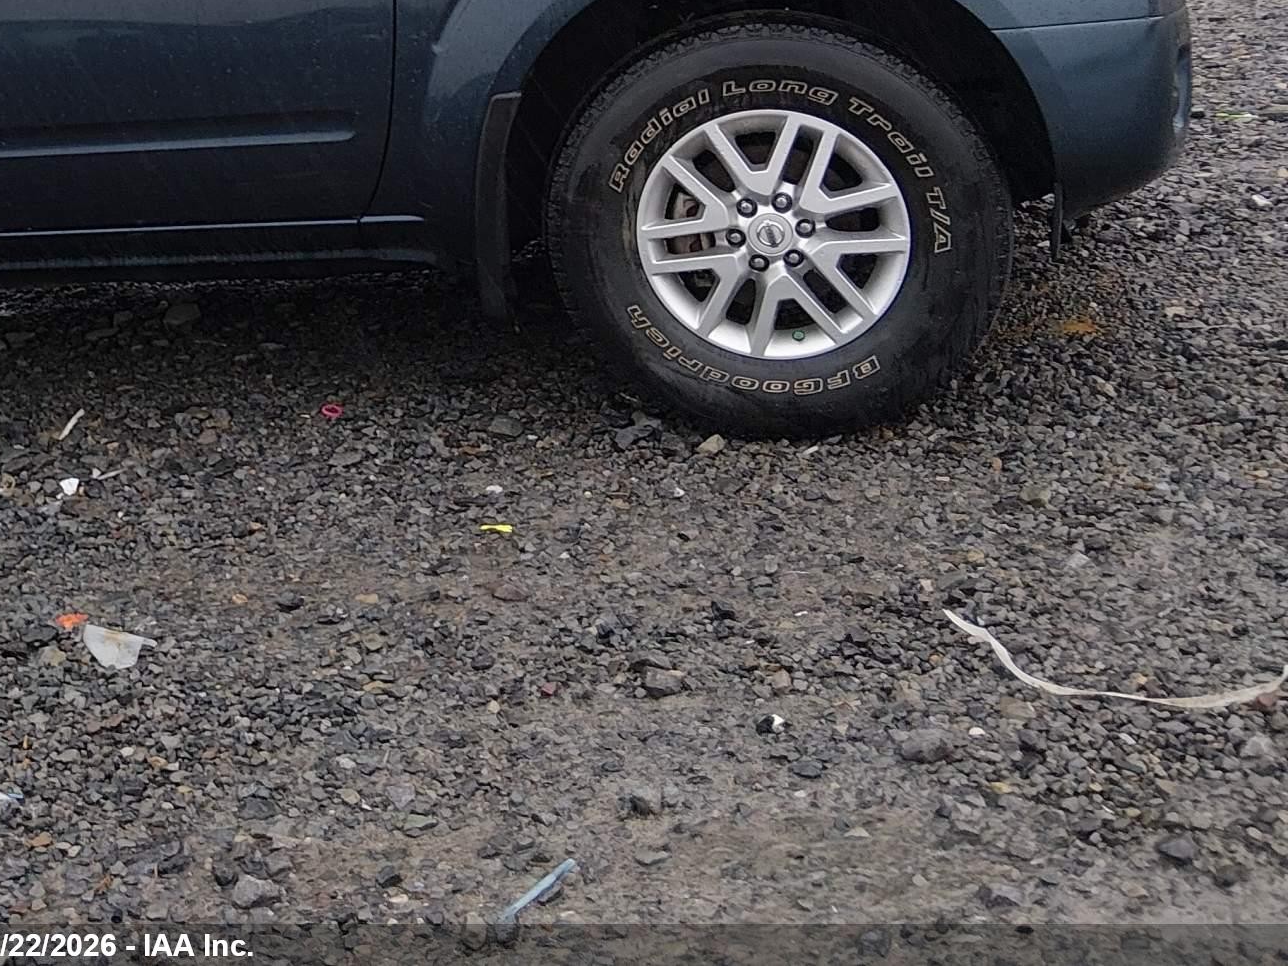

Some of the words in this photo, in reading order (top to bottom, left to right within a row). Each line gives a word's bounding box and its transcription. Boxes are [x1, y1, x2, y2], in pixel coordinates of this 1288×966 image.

[608, 88, 710, 193] Radial
[722, 78, 839, 104] Long
[847, 97, 933, 179] Trail
[925, 186, 953, 254] T/A
[626, 304, 882, 396] BFGoodrich
